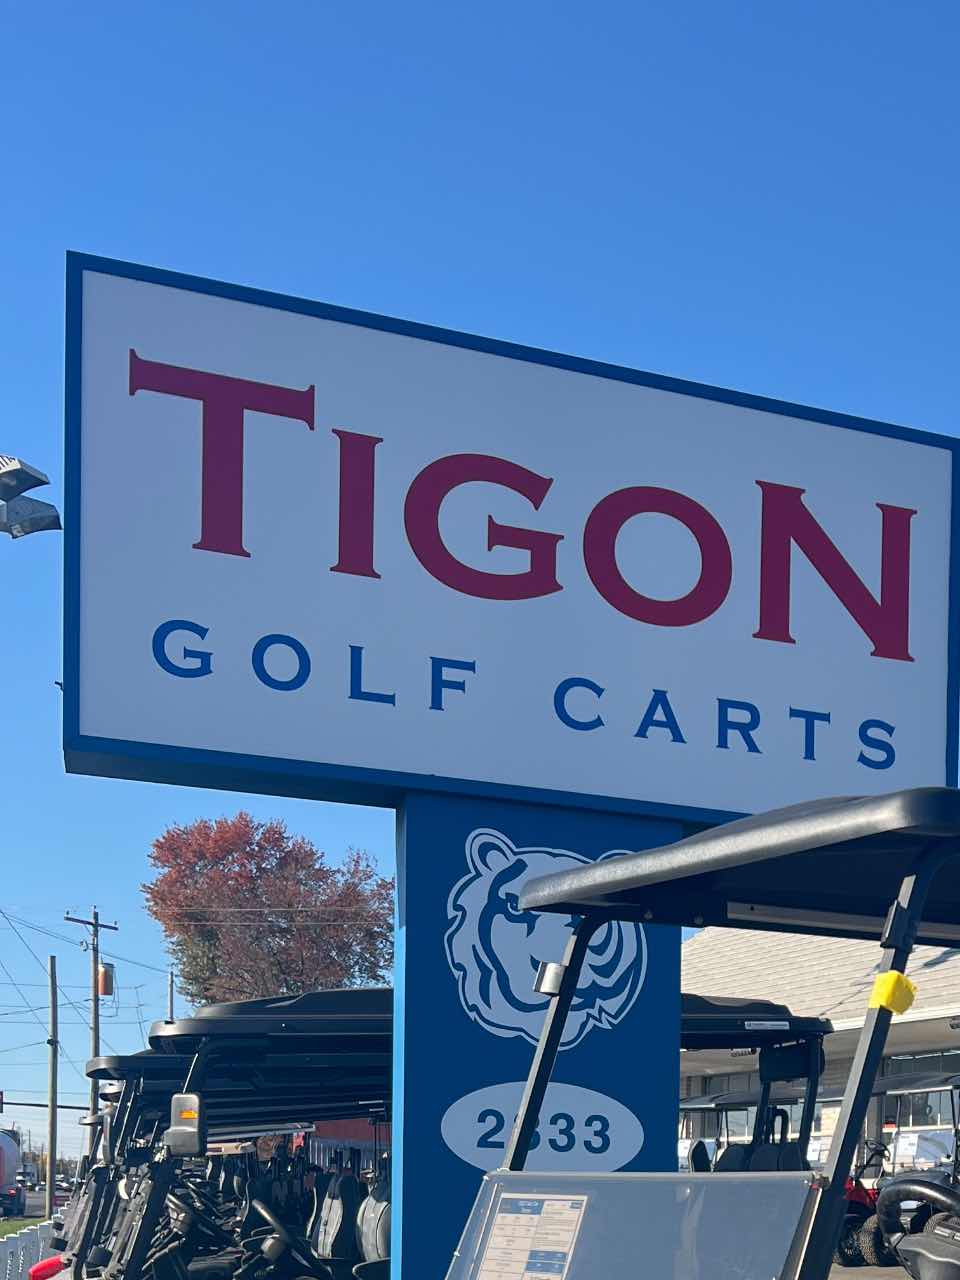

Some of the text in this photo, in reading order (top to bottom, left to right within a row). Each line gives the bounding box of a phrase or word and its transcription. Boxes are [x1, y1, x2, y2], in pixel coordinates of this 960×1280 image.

[128, 348, 918, 662] TIGON
[151, 619, 897, 770] GOLF CARTS
